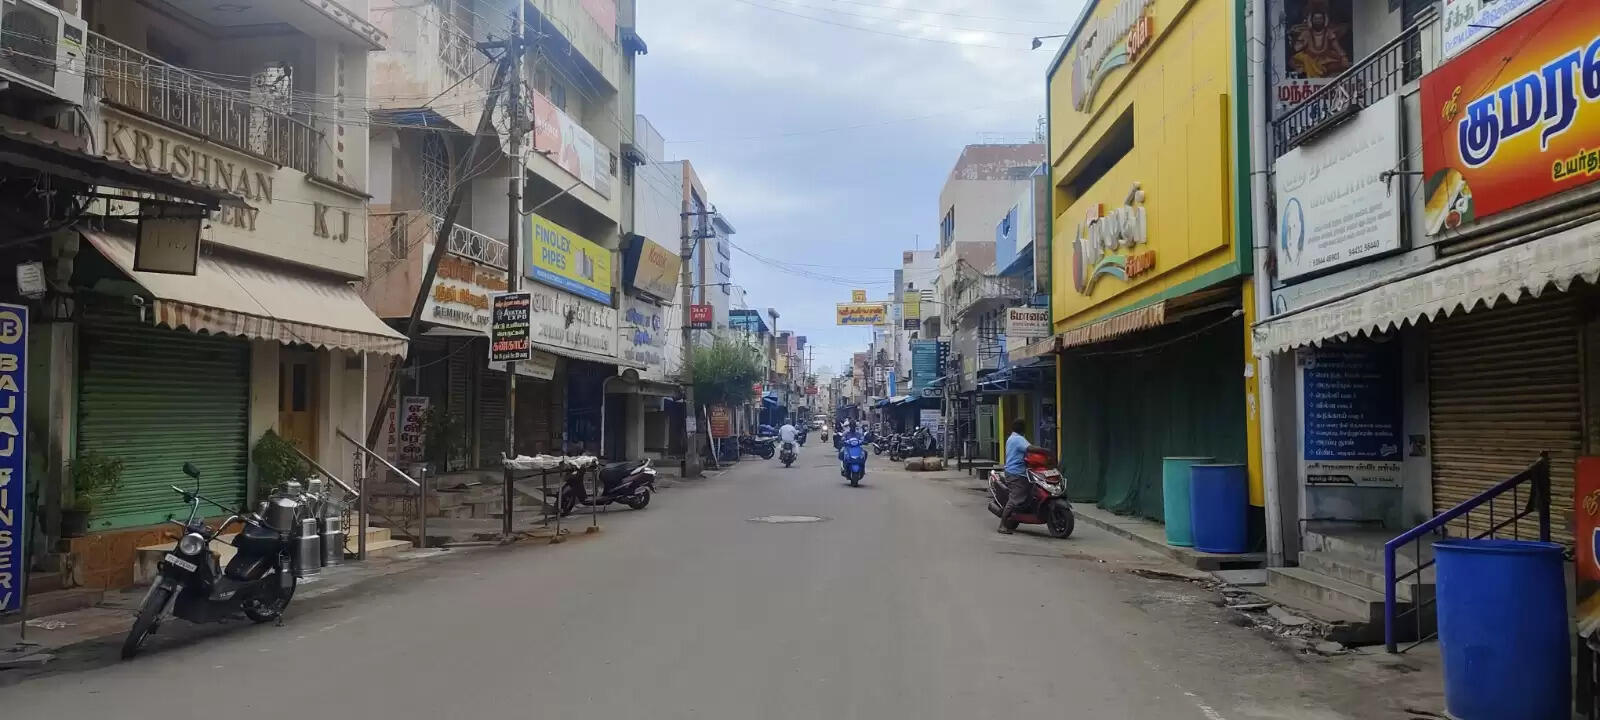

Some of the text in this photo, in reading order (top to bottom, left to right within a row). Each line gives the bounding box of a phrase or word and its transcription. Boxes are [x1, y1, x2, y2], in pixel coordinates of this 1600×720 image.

[103, 118, 274, 205] KRISHNAN
[535, 223, 572, 255] FINOLEX
[541, 247, 566, 271] PIPES
